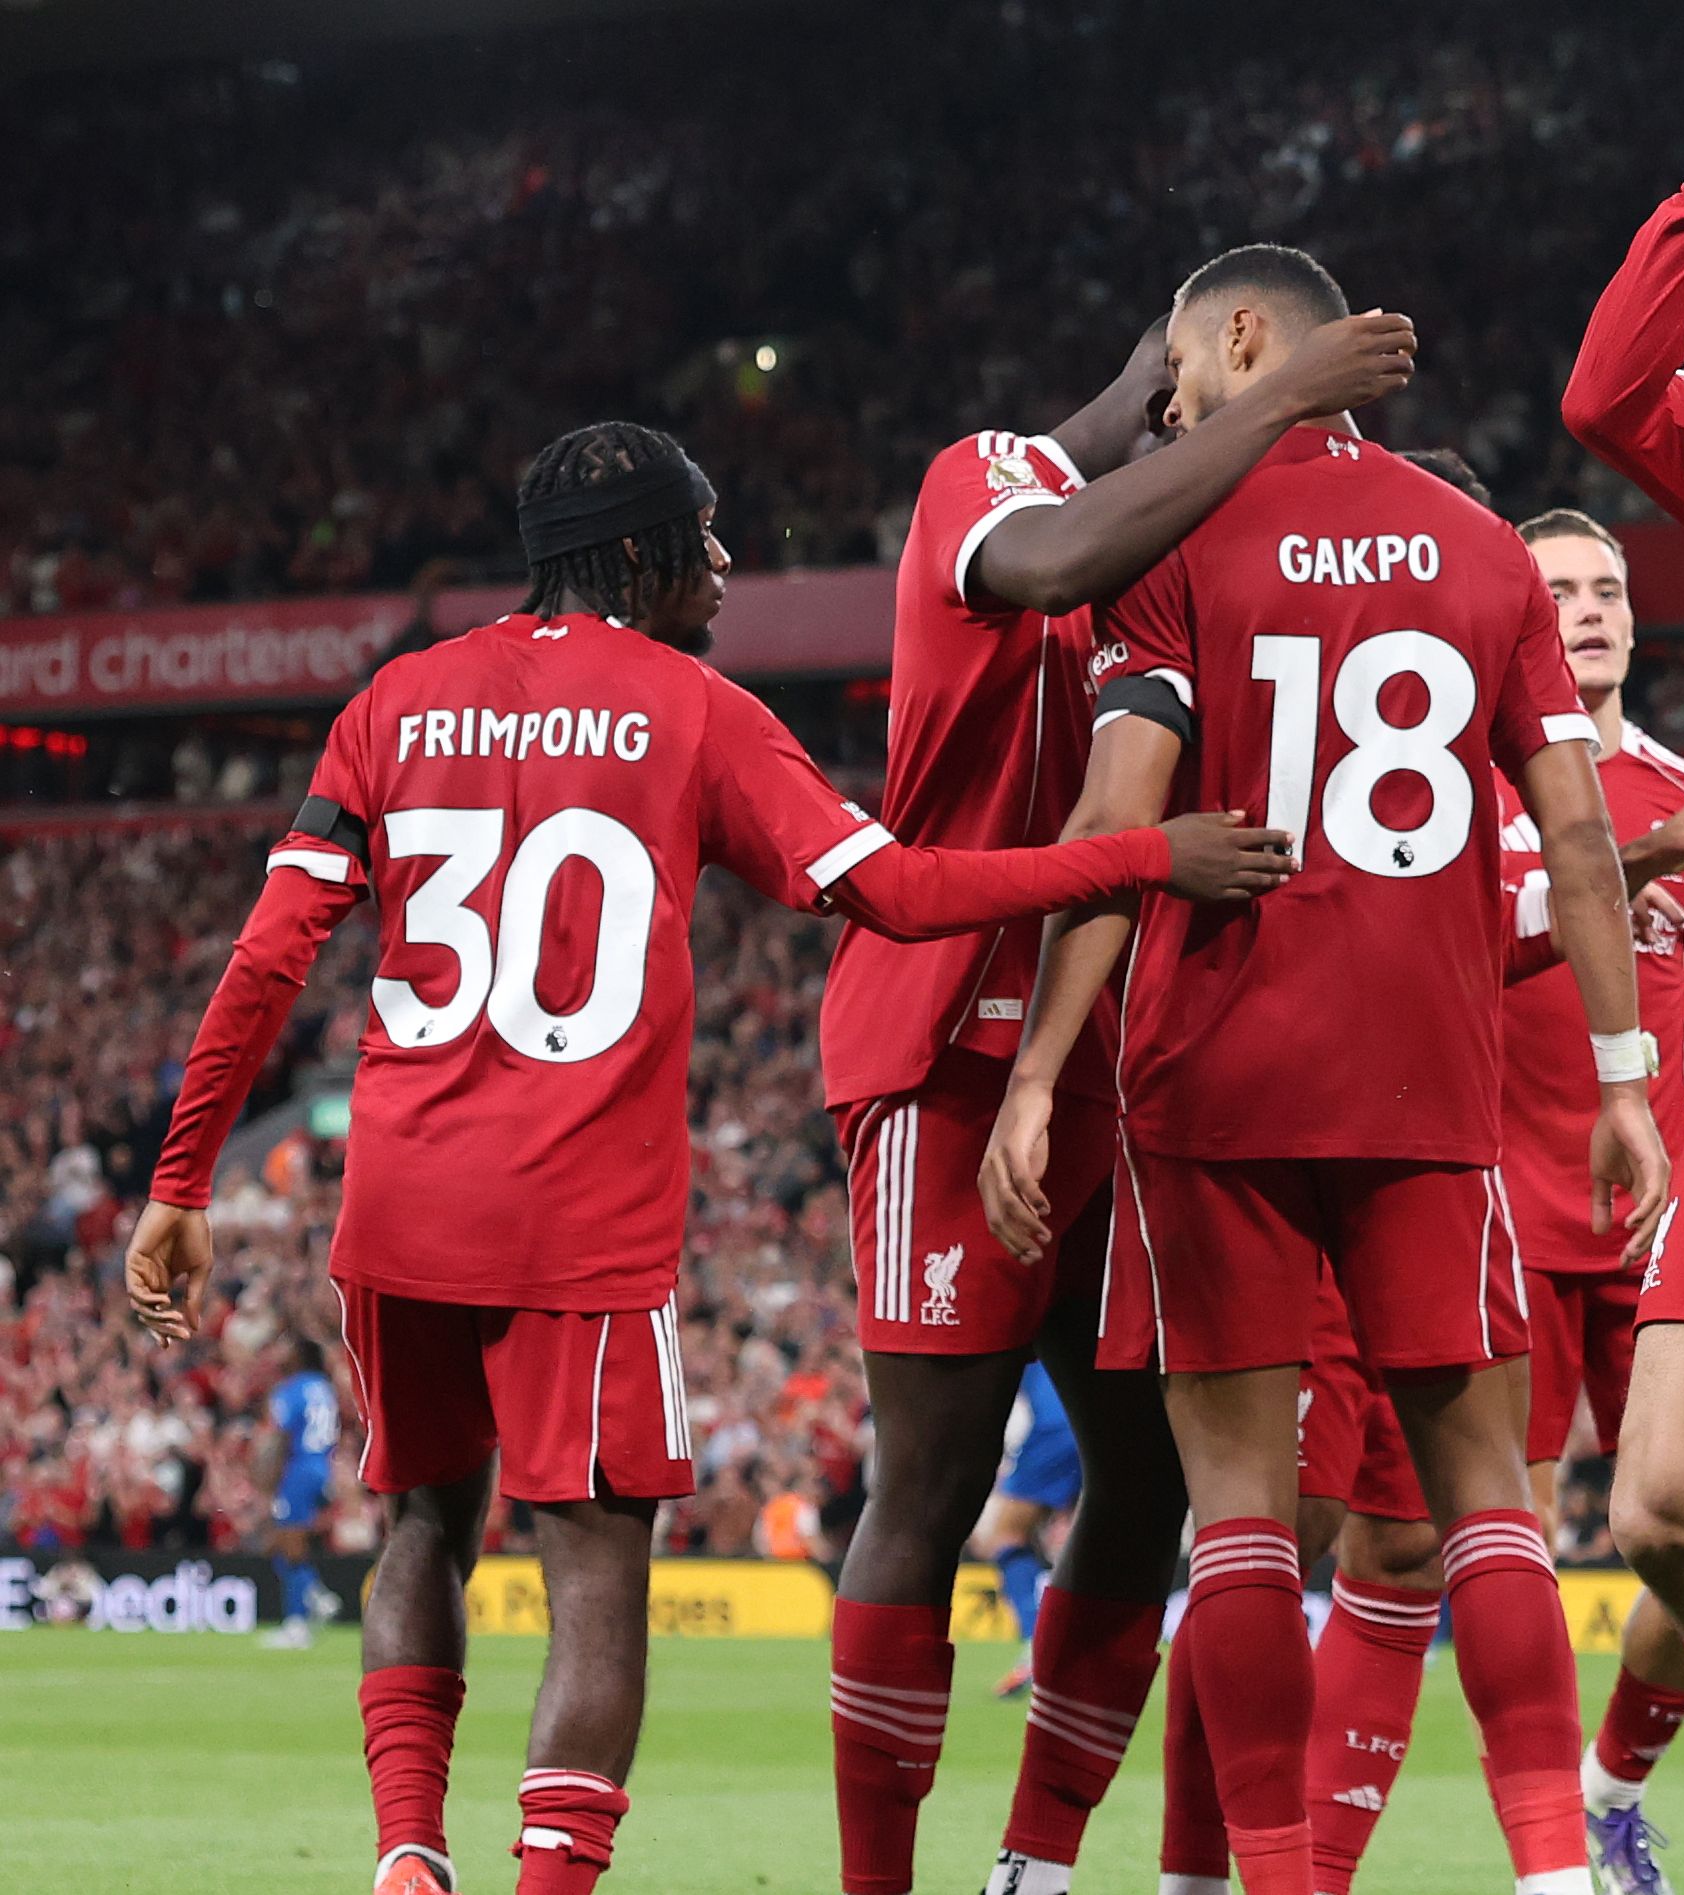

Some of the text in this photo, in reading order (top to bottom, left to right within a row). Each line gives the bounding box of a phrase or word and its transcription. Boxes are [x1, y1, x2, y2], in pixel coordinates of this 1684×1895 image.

[1278, 533, 1441, 585] GAKPO
[397, 707, 651, 762] FRIMPONG
[1251, 629, 1478, 879] 18
[371, 806, 657, 1063] 30
[0, 1556, 258, 1633] Eedia
